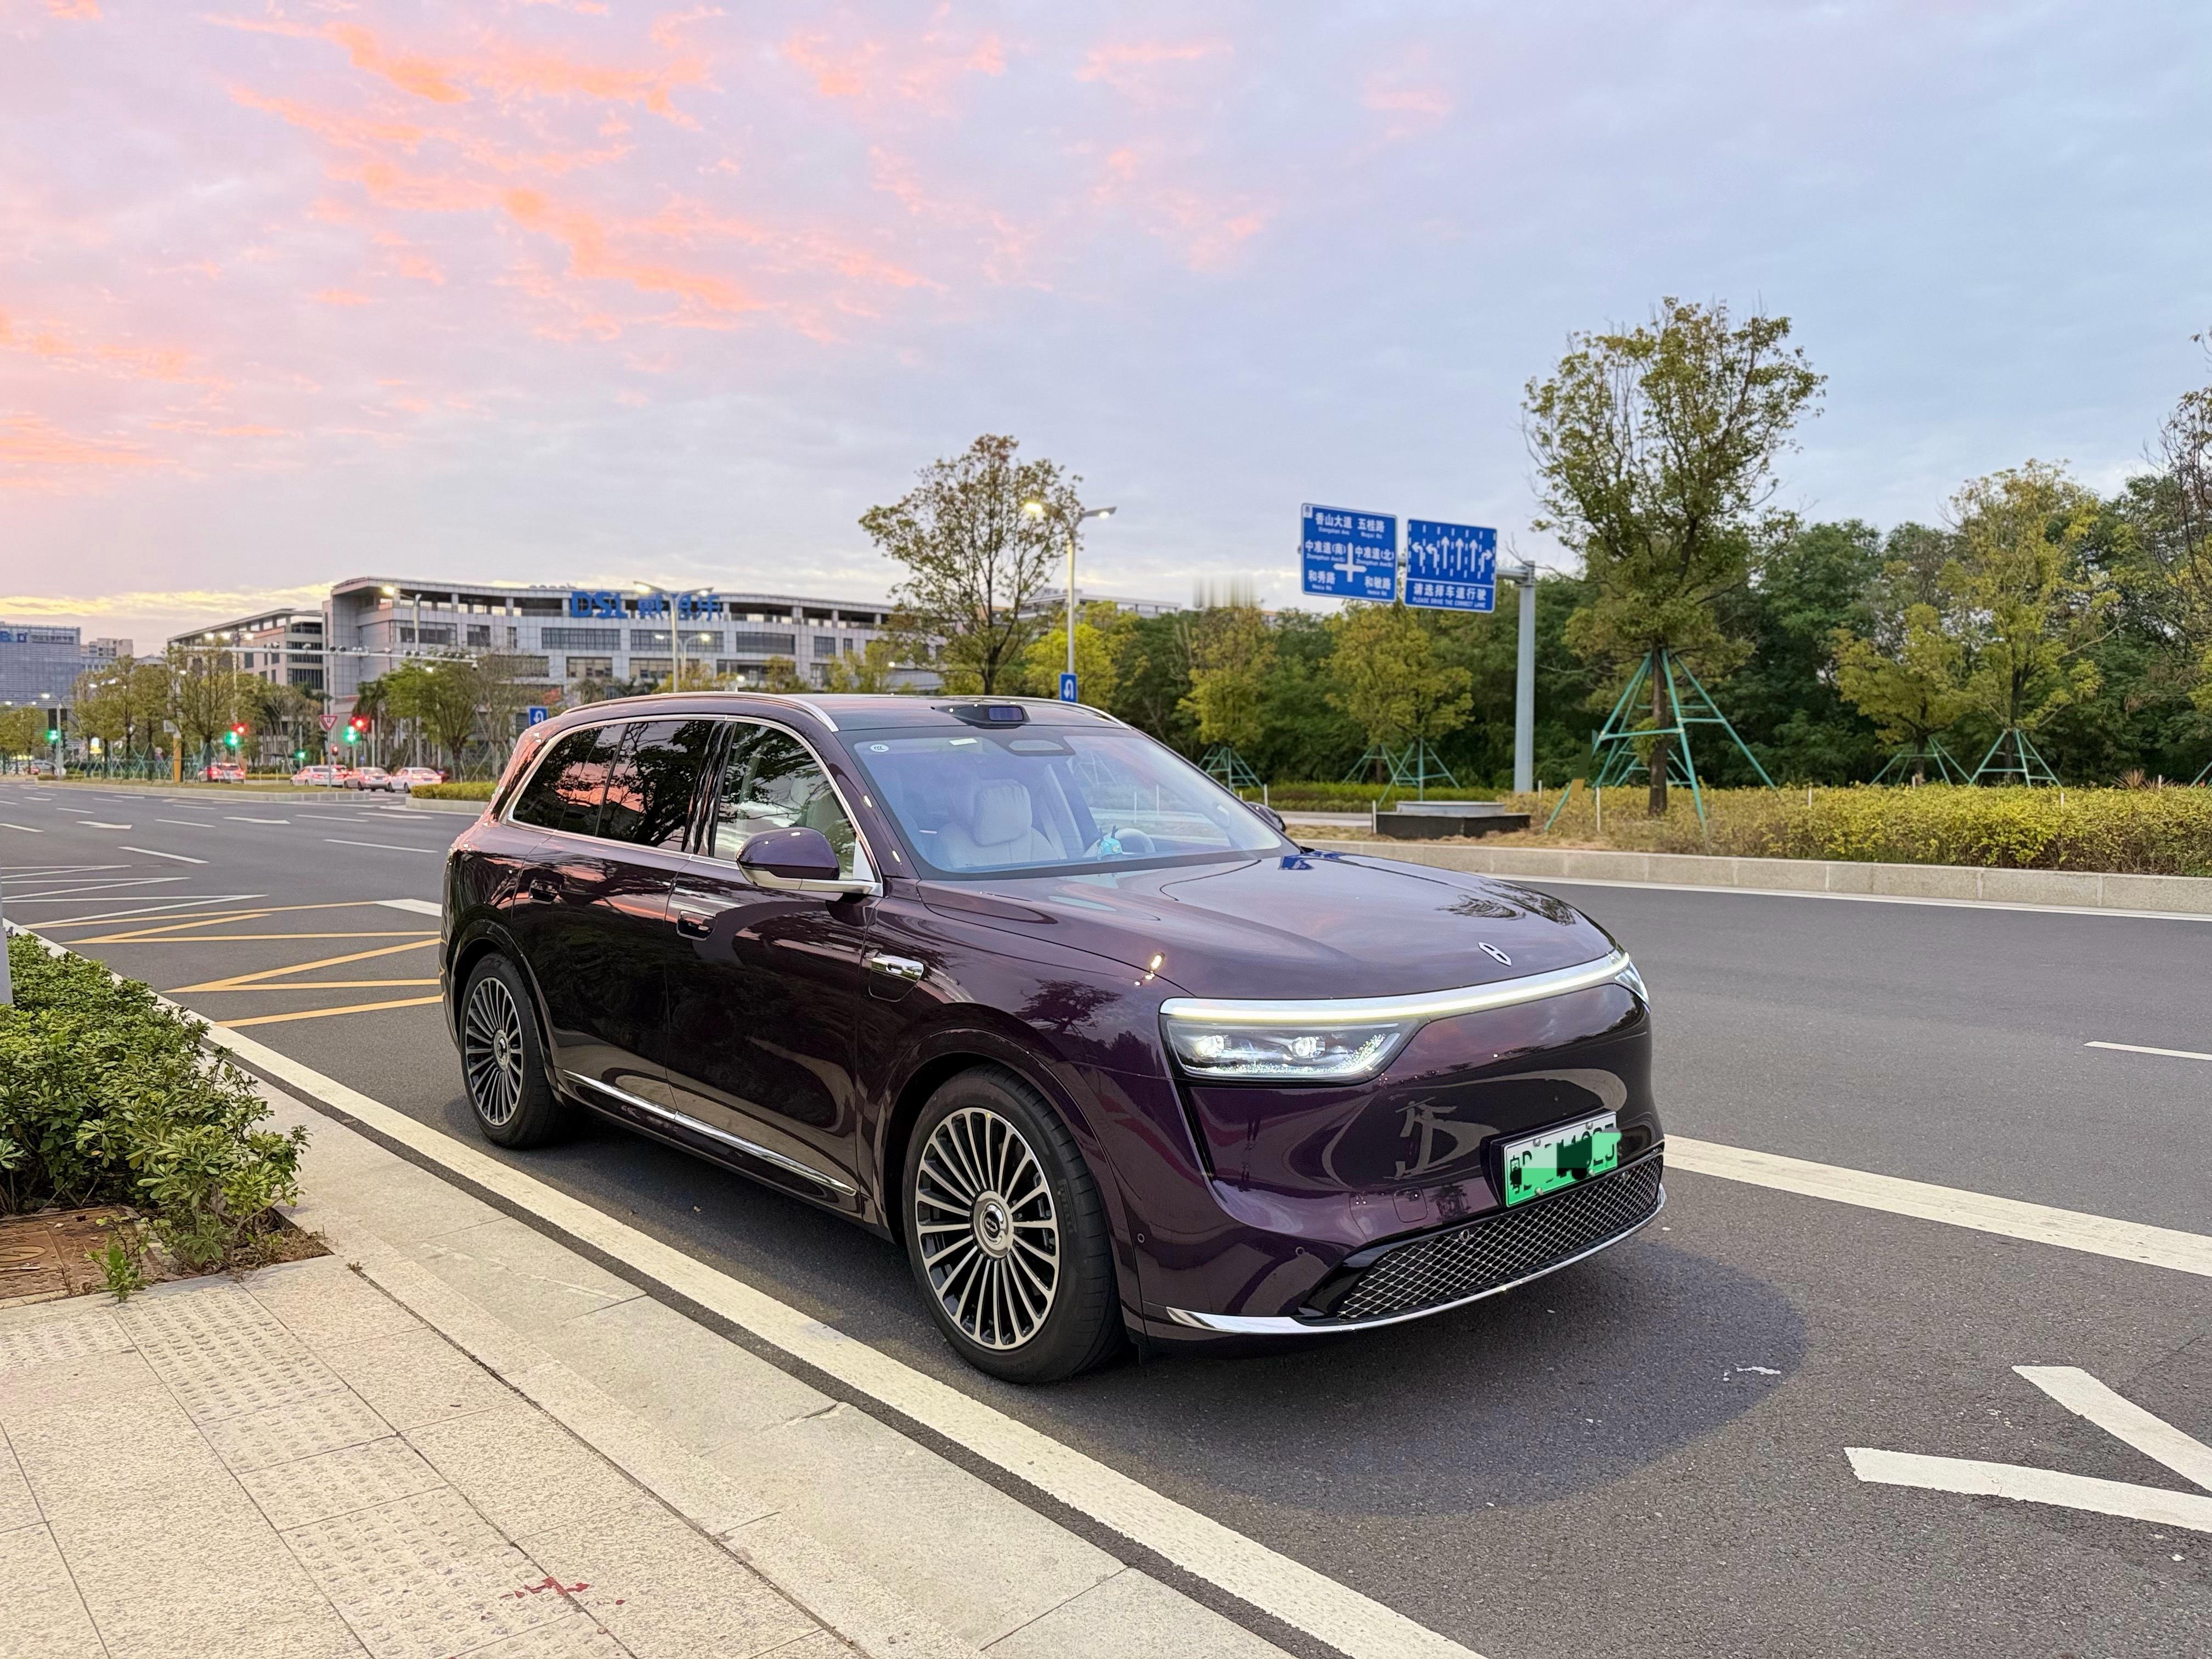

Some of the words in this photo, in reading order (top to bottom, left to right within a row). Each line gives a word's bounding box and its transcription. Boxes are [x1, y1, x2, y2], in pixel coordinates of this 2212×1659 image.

[1316, 512, 1352, 529] 香山大道
[1413, 583, 1487, 601] 请选择车道行驶
[571, 591, 629, 618] DSL
